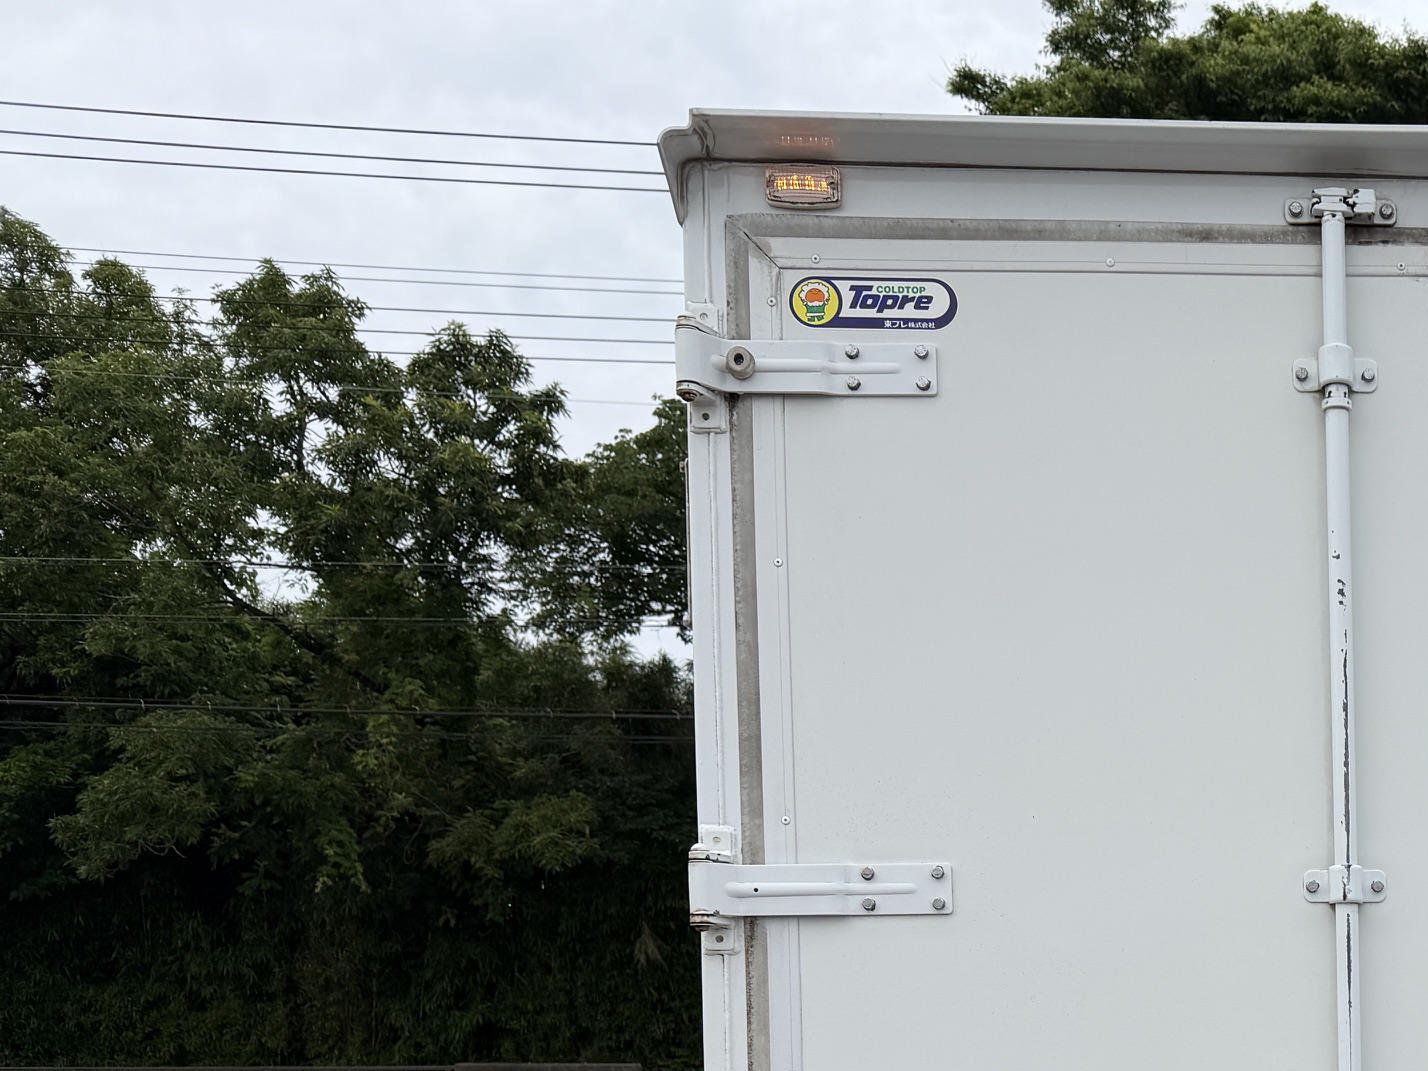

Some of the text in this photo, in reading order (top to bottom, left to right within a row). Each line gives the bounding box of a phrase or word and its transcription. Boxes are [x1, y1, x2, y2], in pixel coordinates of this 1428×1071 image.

[876, 285, 926, 294] COLDTOP
[848, 285, 934, 314] Topre
[884, 320, 936, 329] 東プレ株式会社
